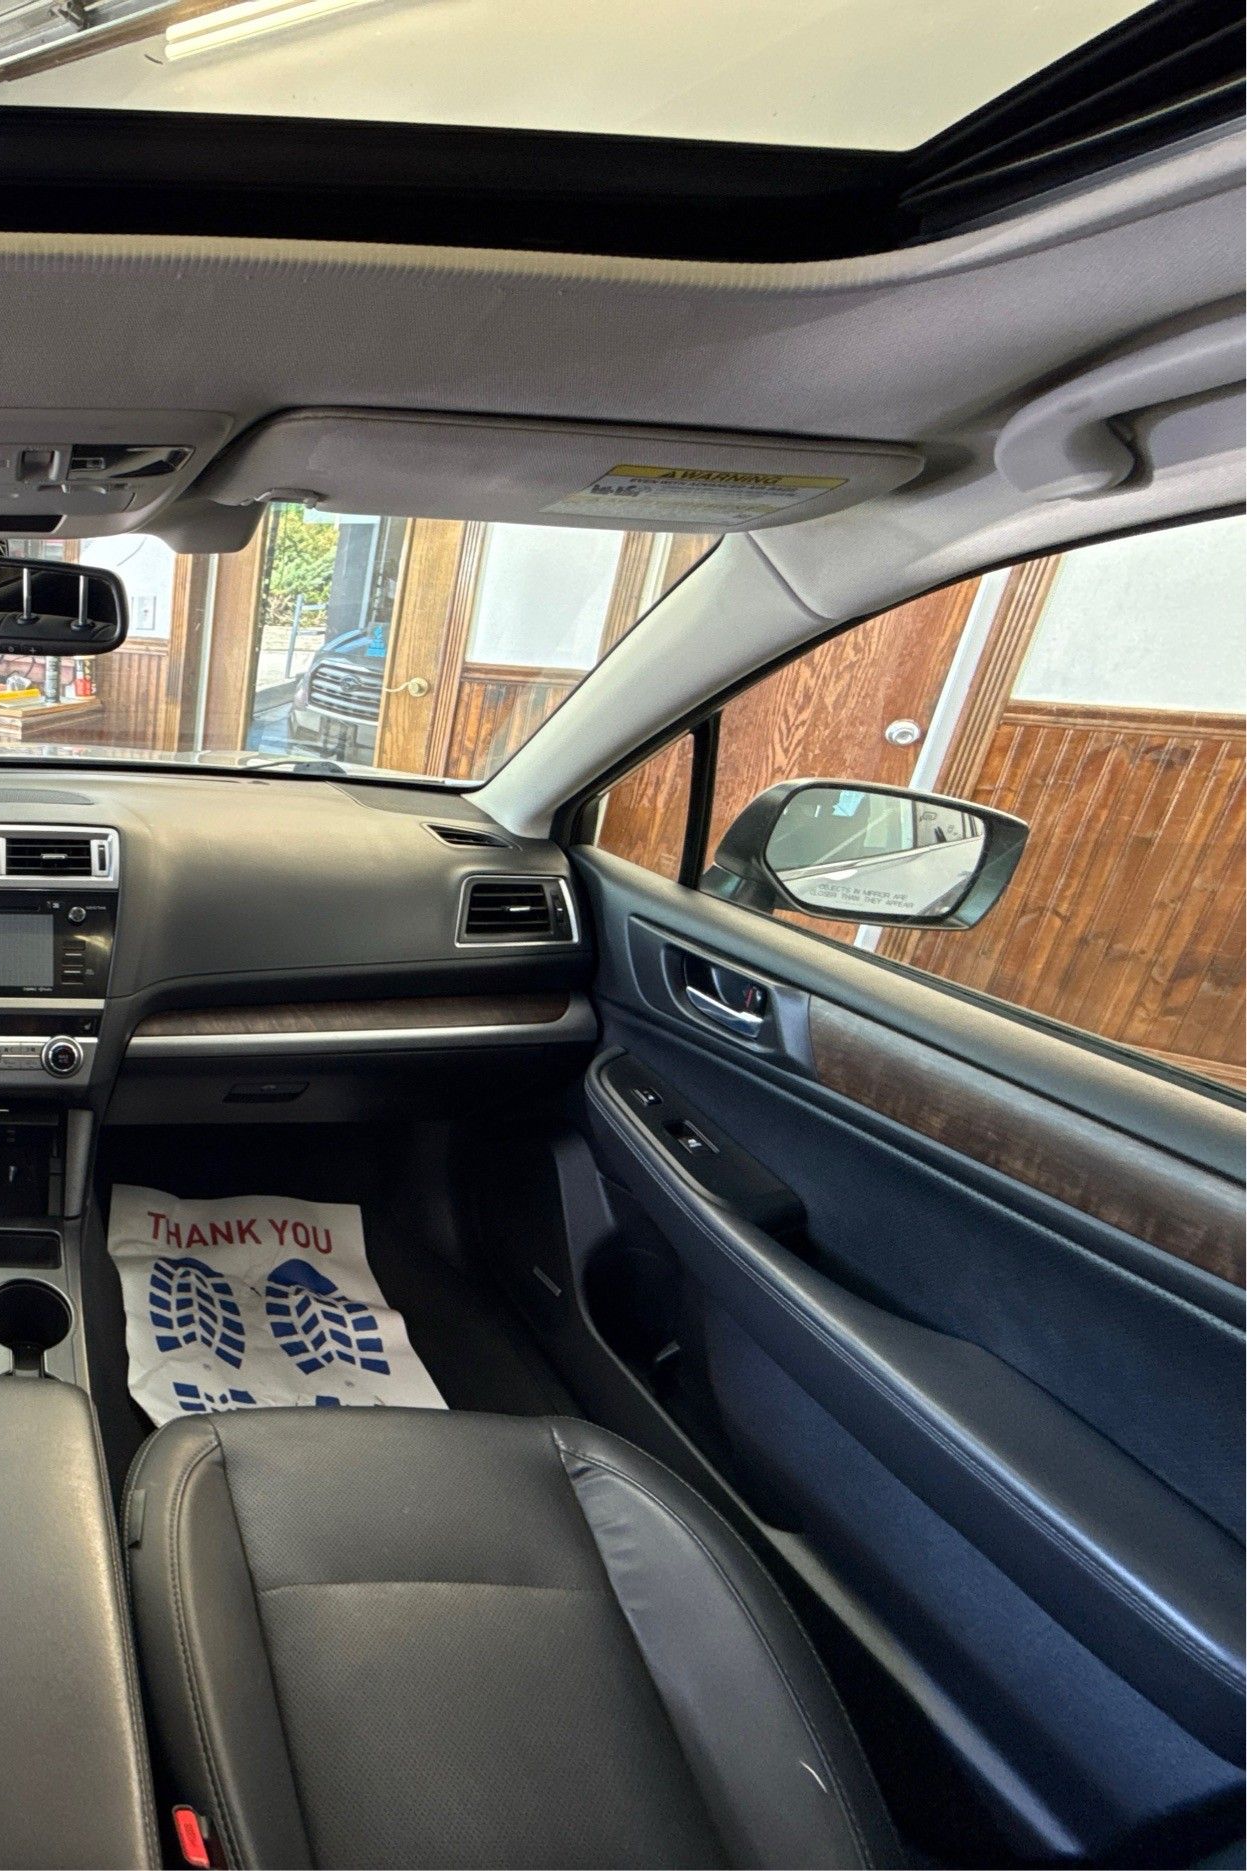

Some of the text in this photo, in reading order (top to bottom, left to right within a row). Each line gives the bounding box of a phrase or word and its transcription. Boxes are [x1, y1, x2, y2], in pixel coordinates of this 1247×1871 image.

[680, 470, 782, 485] WARNING
[147, 1211, 333, 1255] THANK YOU
